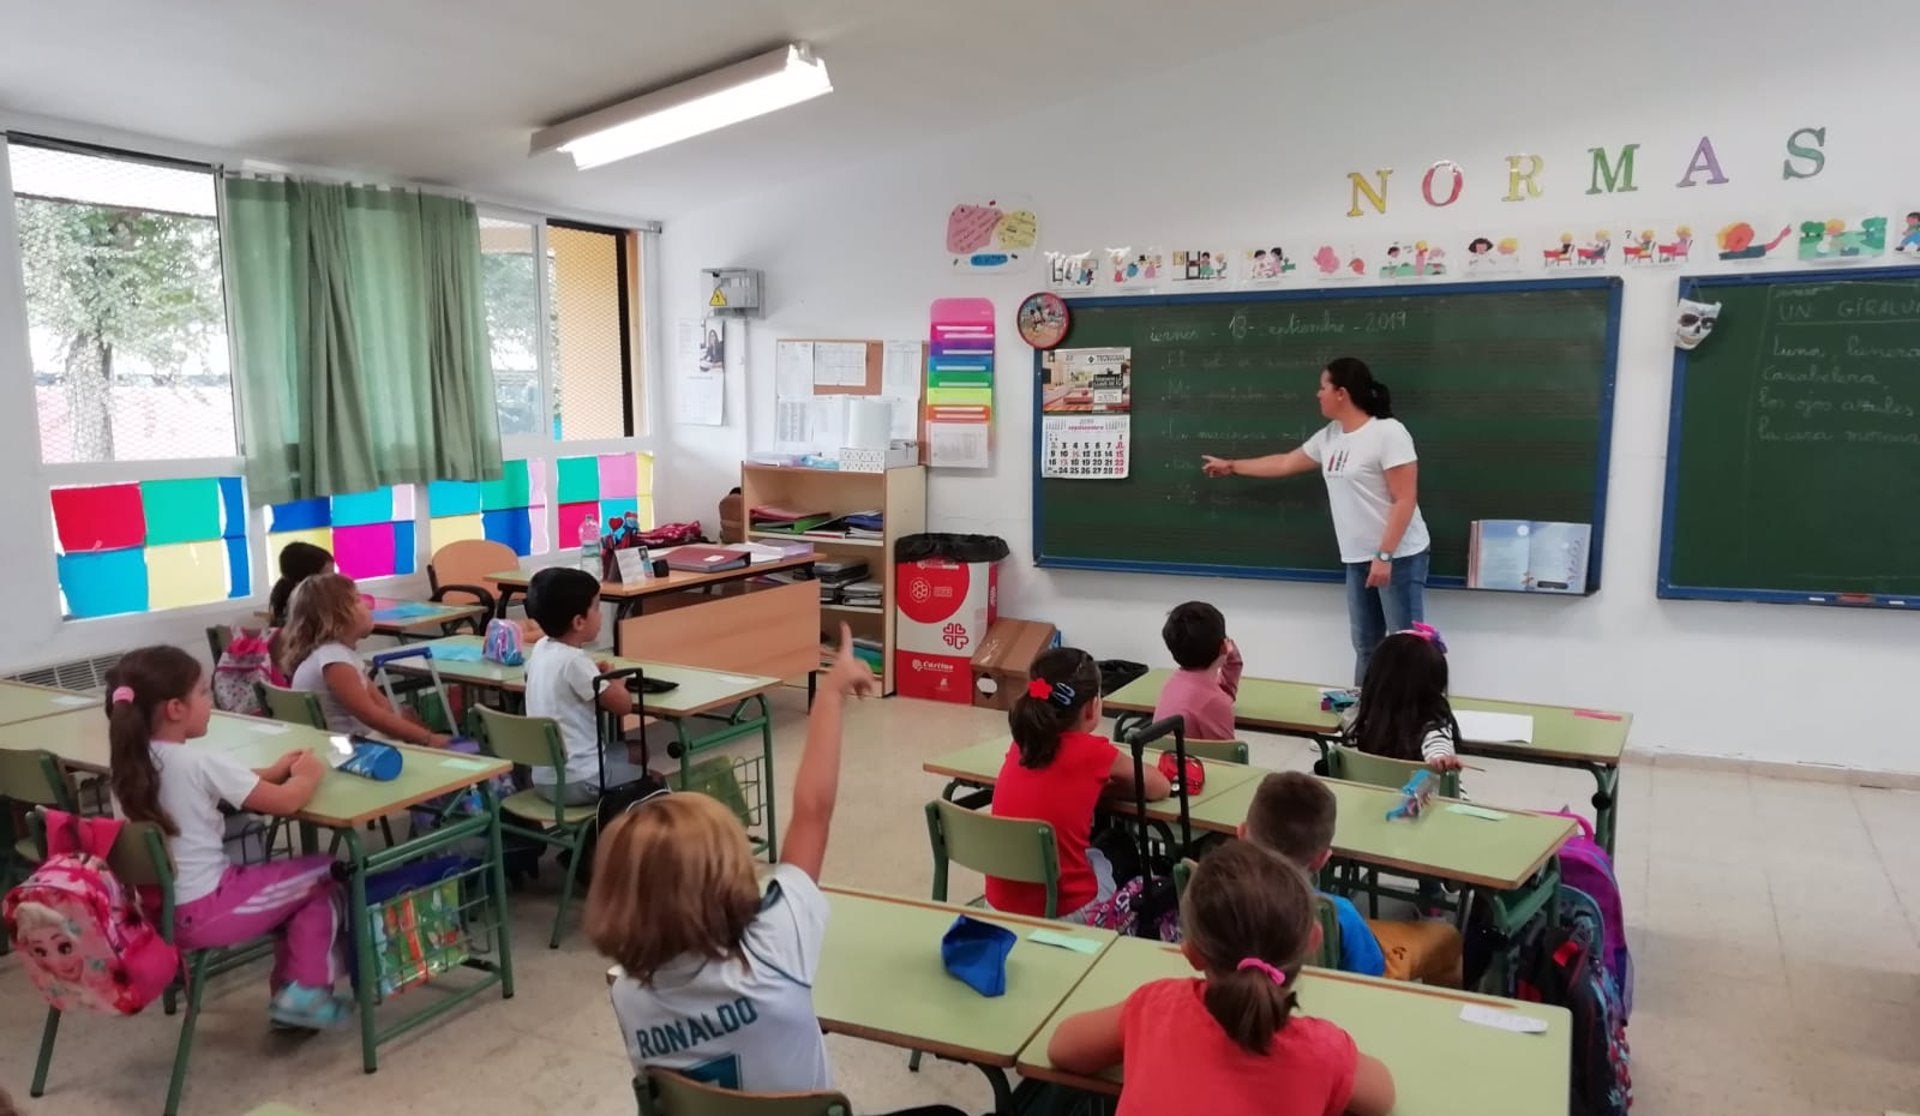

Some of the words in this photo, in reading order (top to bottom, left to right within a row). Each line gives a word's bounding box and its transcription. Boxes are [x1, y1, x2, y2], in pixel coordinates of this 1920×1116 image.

[1346, 126, 1827, 218] NORMAS
[1060, 450, 1068, 458] 10
[635, 996, 758, 1059] RONALDO
